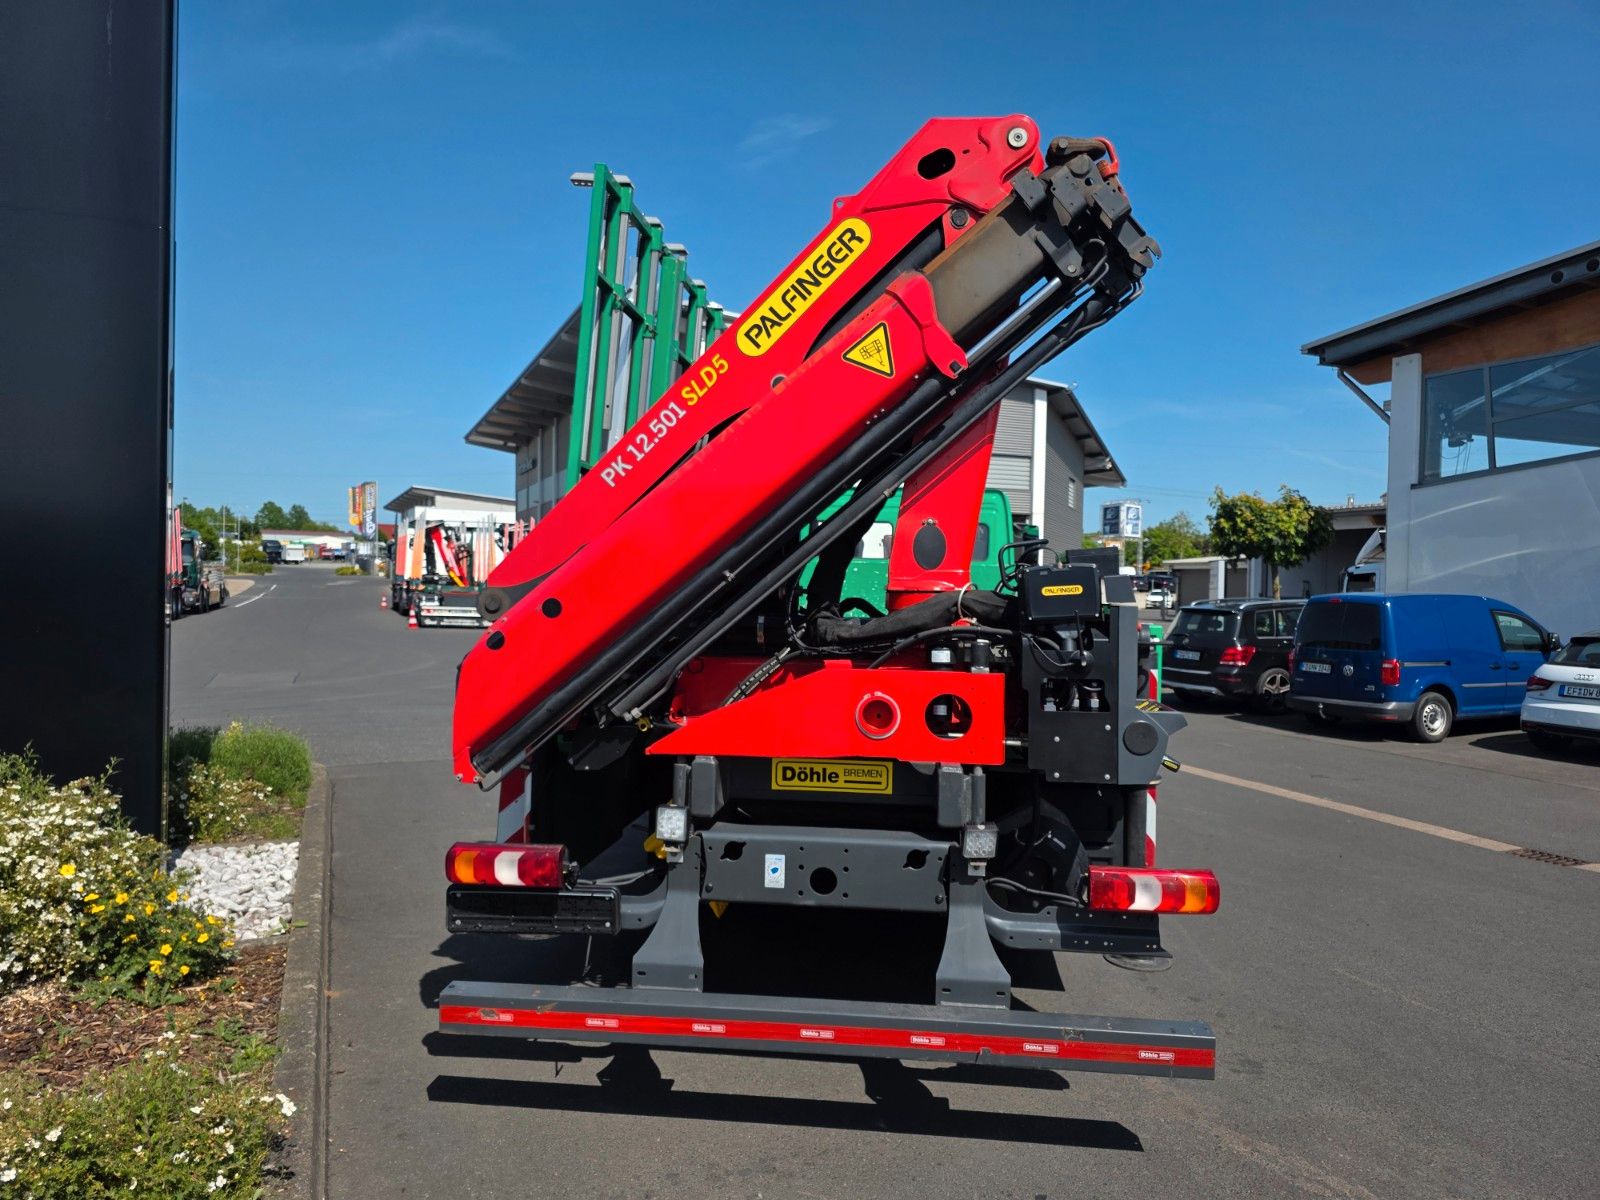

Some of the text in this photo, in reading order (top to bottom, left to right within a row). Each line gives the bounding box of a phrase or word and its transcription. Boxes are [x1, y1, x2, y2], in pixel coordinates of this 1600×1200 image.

[743, 227, 865, 349] PALFINGER
[600, 354, 729, 488] PK 12.501 SLD5
[782, 766, 882, 783] Döhle BREMEN
